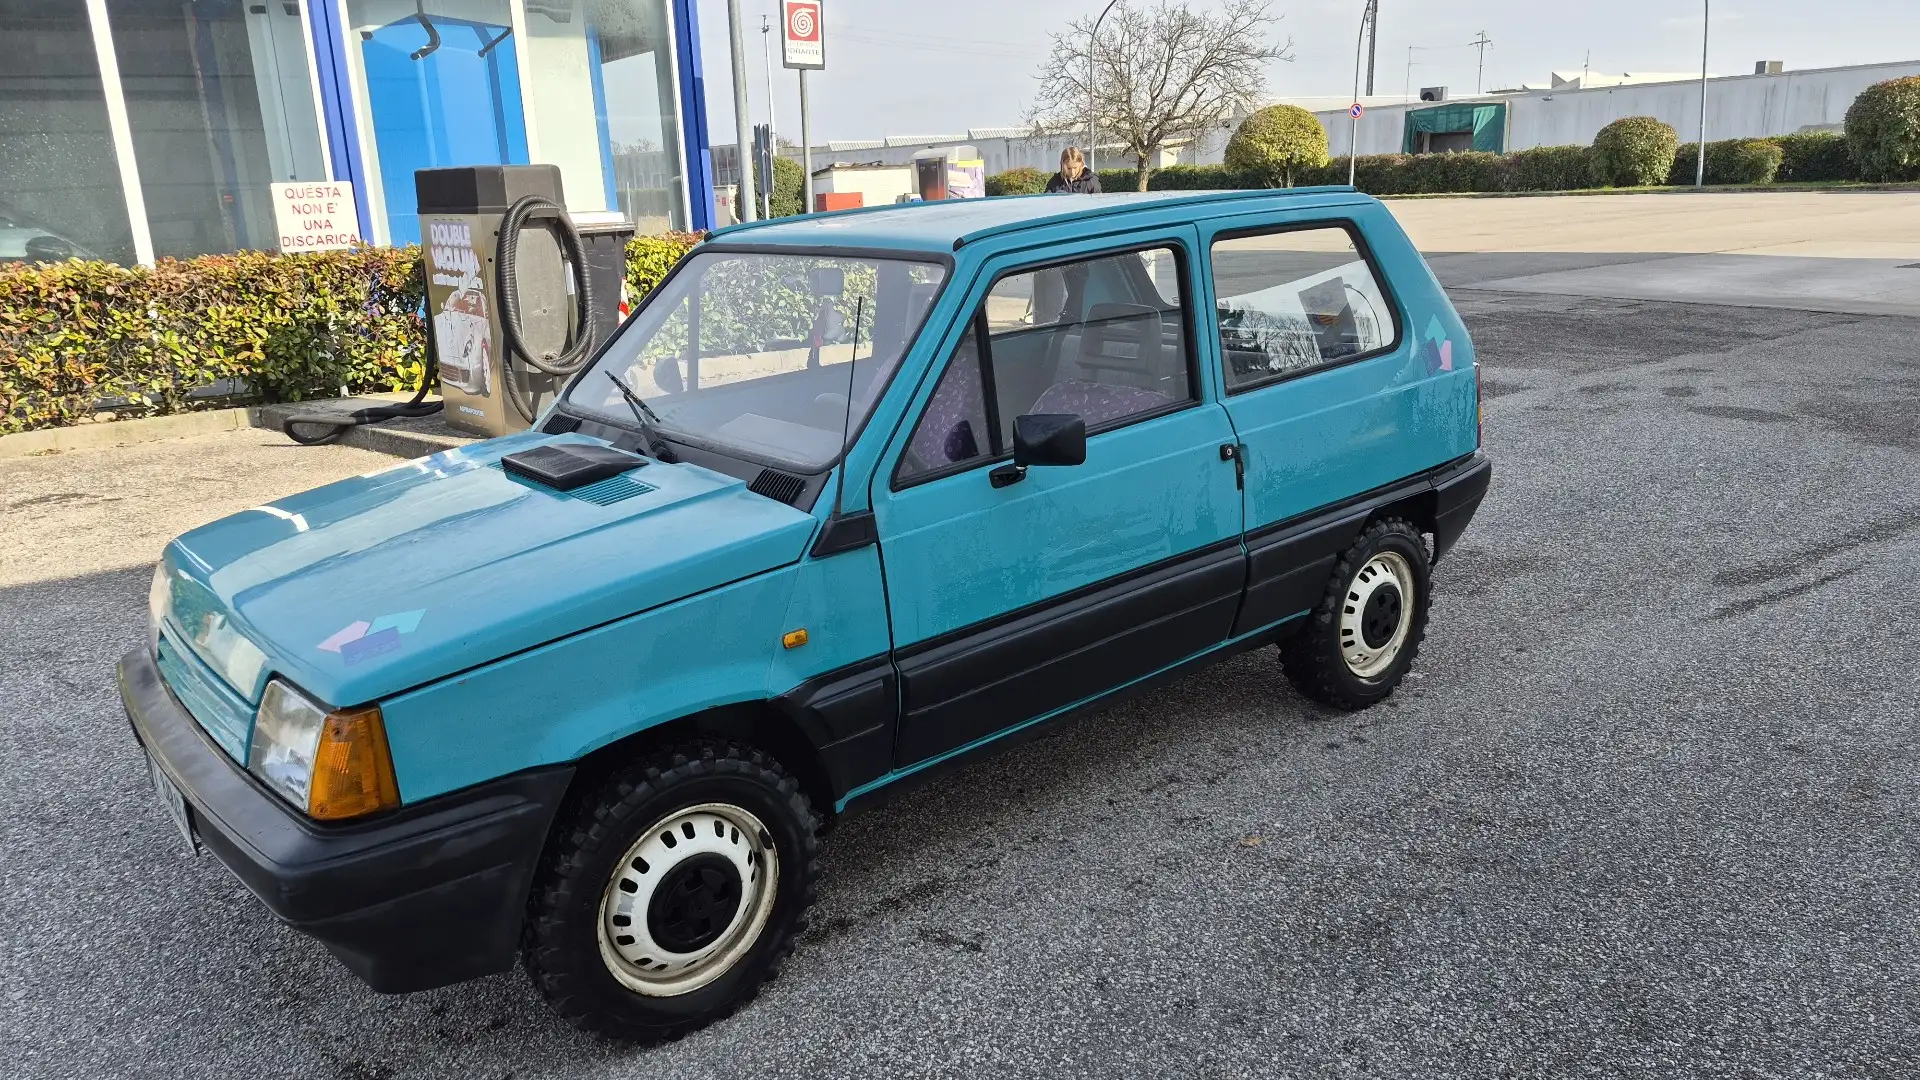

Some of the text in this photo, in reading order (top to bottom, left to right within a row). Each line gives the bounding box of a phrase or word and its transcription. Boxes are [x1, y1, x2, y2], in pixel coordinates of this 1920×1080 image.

[285, 187, 341, 199] QUESTA
[292, 202, 338, 215] NON E'
[303, 219, 333, 231] UNA
[281, 234, 358, 247] DISCARICA
[430, 223, 472, 247] DOUBLE
